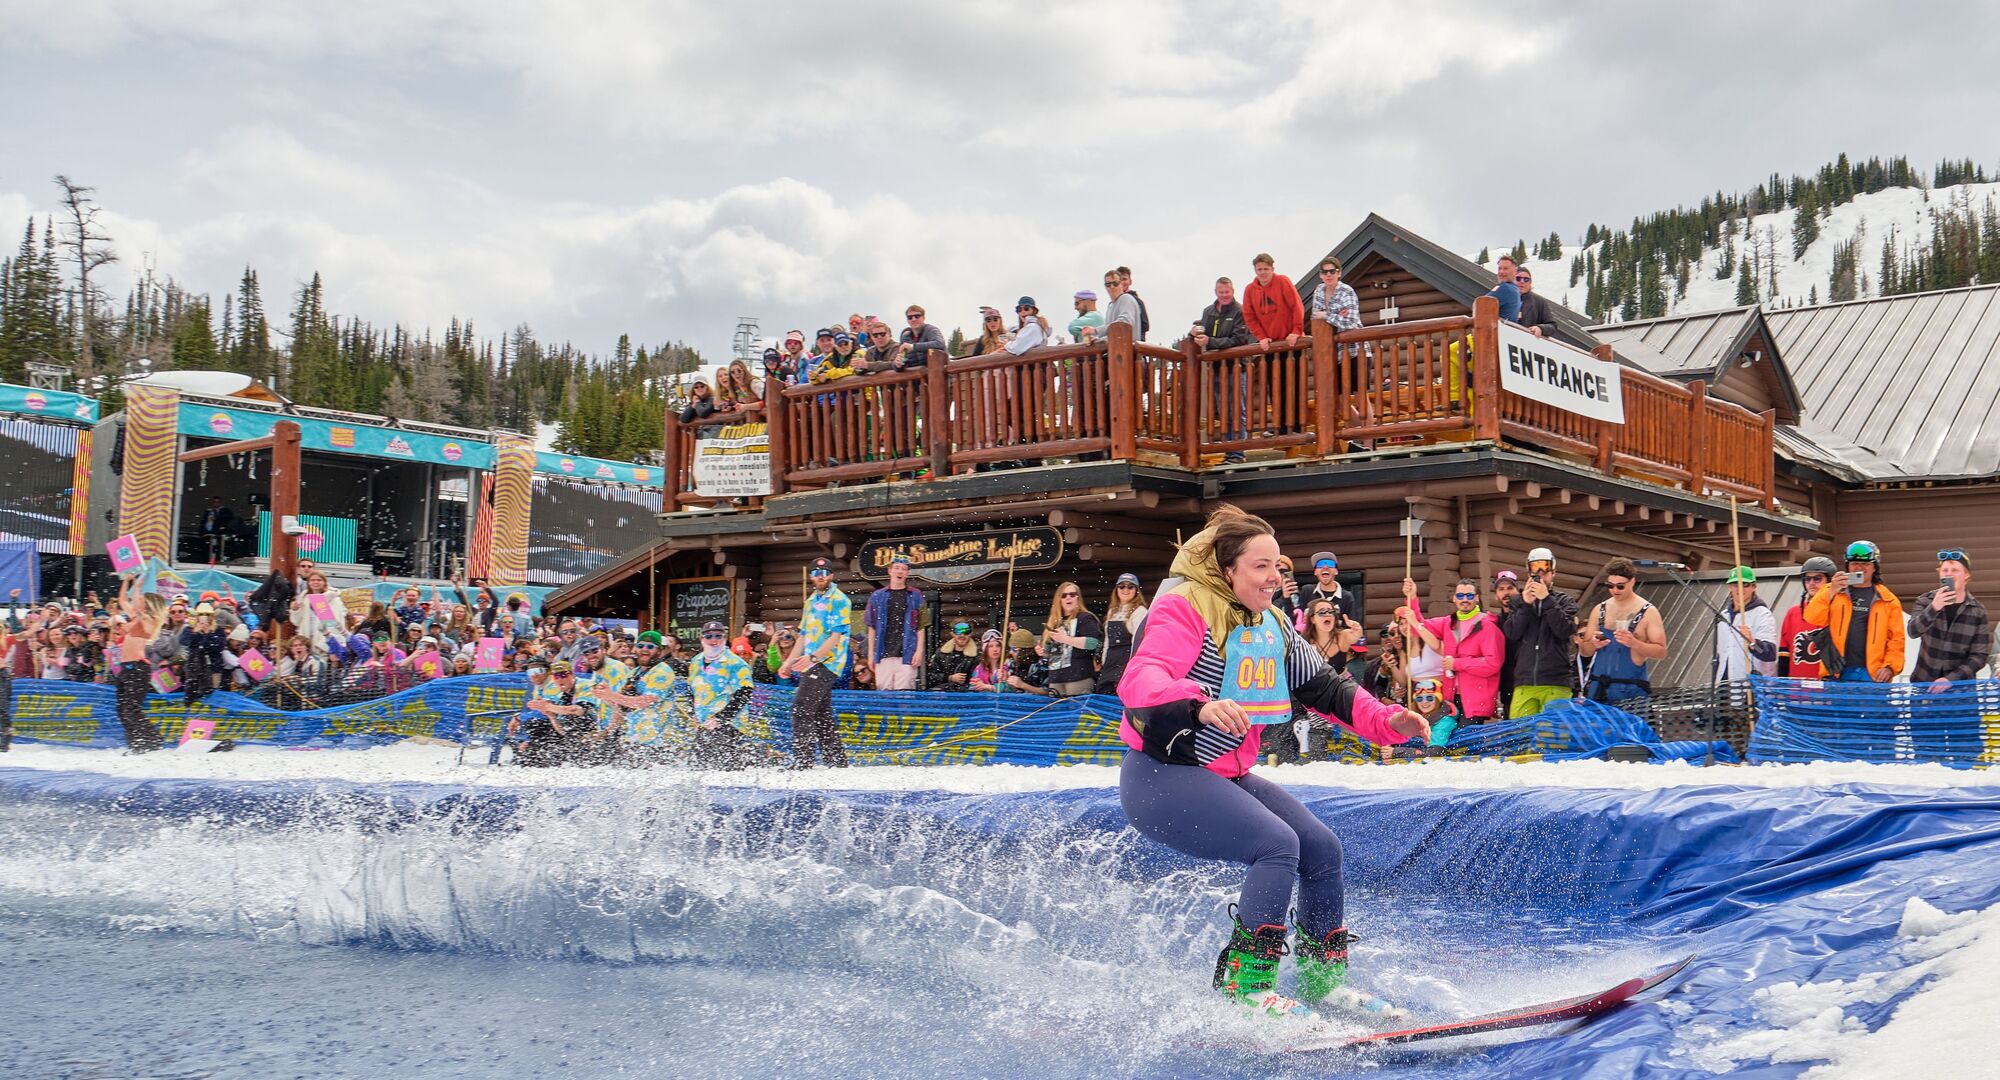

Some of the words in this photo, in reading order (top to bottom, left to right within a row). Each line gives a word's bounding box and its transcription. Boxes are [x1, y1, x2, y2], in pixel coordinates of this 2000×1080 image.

[1508, 344, 1609, 403] ENTRANCE
[909, 539, 983, 565] Sunshine
[986, 538, 1042, 561] Lodge
[1236, 656, 1276, 690] 040
